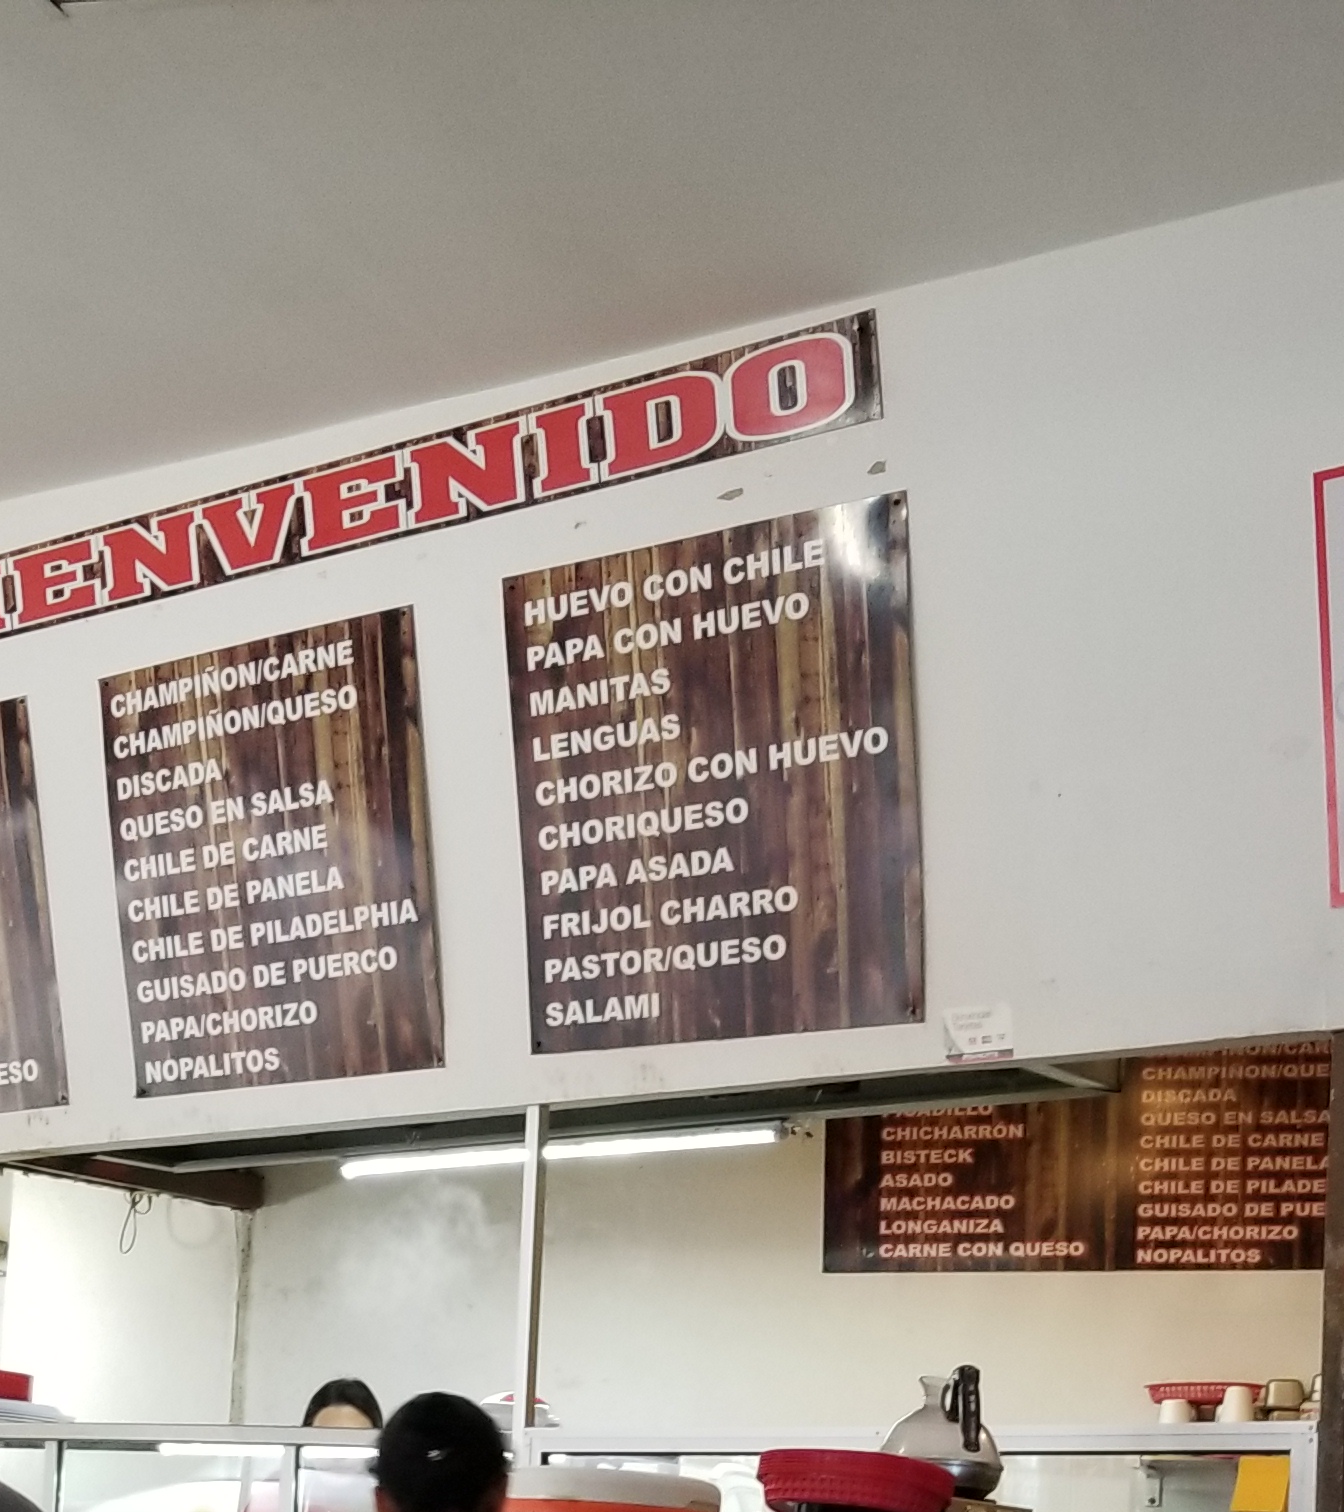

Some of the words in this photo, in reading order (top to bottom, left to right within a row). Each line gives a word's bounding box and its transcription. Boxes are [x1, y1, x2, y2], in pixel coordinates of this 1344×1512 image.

[524, 581, 633, 626] HUEVO
[643, 564, 713, 602] CON
[723, 539, 826, 584] CHILE
[527, 635, 606, 671] PAPA
[613, 618, 683, 656] CON
[693, 592, 810, 639] HUEVO
[110, 638, 355, 719] CHAMPIÑON/CARNE
[529, 668, 671, 717] MANITAS
[113, 685, 357, 759] CHAMPIÑON/QUESO
[533, 713, 681, 762] LENGUAS
[116, 758, 223, 801] DISCADA
[535, 761, 677, 807] CHORIZO
[687, 745, 758, 784] CON
[769, 726, 889, 772] HUEVO
[120, 805, 203, 841] QUESO
[213, 797, 244, 825] EN
[250, 780, 334, 817] SALSA
[538, 798, 749, 851] CHORIQUESO
[124, 848, 195, 882] CHILE
[203, 840, 235, 869] DE
[242, 824, 328, 862] CARNE
[540, 863, 617, 895] PAPA
[626, 847, 735, 886] ASADA
[127, 890, 200, 923] CHILE
[207, 882, 239, 912] DE
[246, 867, 344, 905] PANELA
[543, 901, 651, 939] FRIJOL
[660, 886, 799, 926] CHARRO
[132, 931, 204, 963] CHILE
[211, 923, 244, 952] DE
[250, 899, 418, 948] PILADELPHIA
[137, 967, 246, 1003] GUISADO
[253, 960, 286, 988] DE
[292, 946, 398, 982] PUERCO
[545, 934, 787, 984] PASTOR/QUESO
[141, 1001, 318, 1044] PAPA/CHORIZO
[545, 992, 660, 1027] SALAMI
[145, 1047, 281, 1084] NOPALITOS
[1141, 1087, 1237, 1104] DISCADA
[1140, 1112, 1216, 1126] QUESO
[1223, 1111, 1253, 1124] EN
[1259, 1110, 1330, 1124] SALSA
[880, 1149, 974, 1165] BISTECK
[1140, 1135, 1205, 1148] CHILE
[1212, 1135, 1241, 1147] DE
[1247, 1133, 1324, 1147] CARNE
[879, 1172, 953, 1188] ASADO
[1139, 1158, 1205, 1171] CHILE
[1211, 1157, 1241, 1171] DE
[879, 1195, 1016, 1211] MACHACADO
[1138, 1180, 1204, 1194] CHILE
[1210, 1180, 1239, 1194] DE
[879, 1218, 1004, 1235] LONGANIZA
[1137, 1203, 1238, 1218] GUISADO
[1244, 1202, 1274, 1217] DE
[879, 1243, 952, 1258] CARNE
[956, 1241, 1005, 1258] CON
[1008, 1240, 1085, 1258] QUESO
[1136, 1225, 1299, 1240] PAPA/CHORIZO
[1136, 1248, 1261, 1263] NOPALITOS
